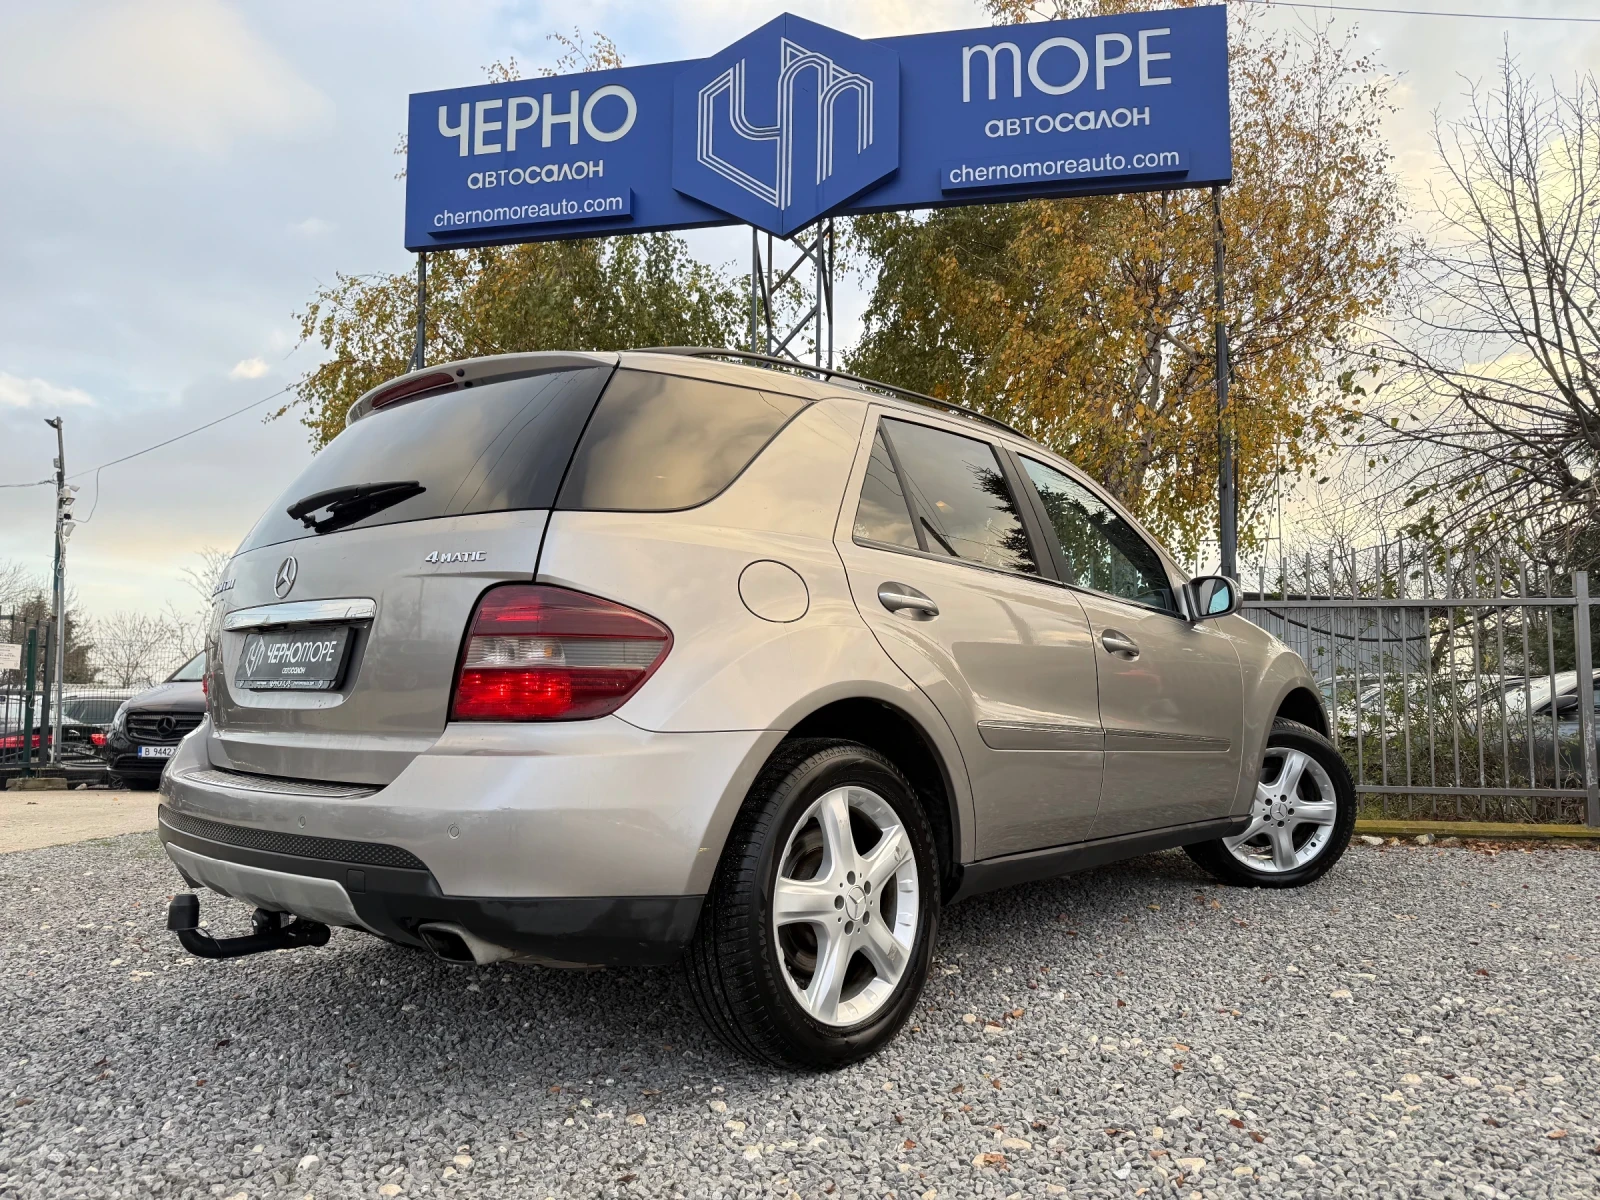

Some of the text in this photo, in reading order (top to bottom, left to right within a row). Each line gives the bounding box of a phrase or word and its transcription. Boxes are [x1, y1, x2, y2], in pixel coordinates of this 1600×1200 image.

[438, 84, 637, 157] ЧЕРНО
[949, 151, 1180, 184] chernomoreauto.com
[433, 195, 623, 227] chernomoreauto.com
[153, 747, 172, 756] 9442
